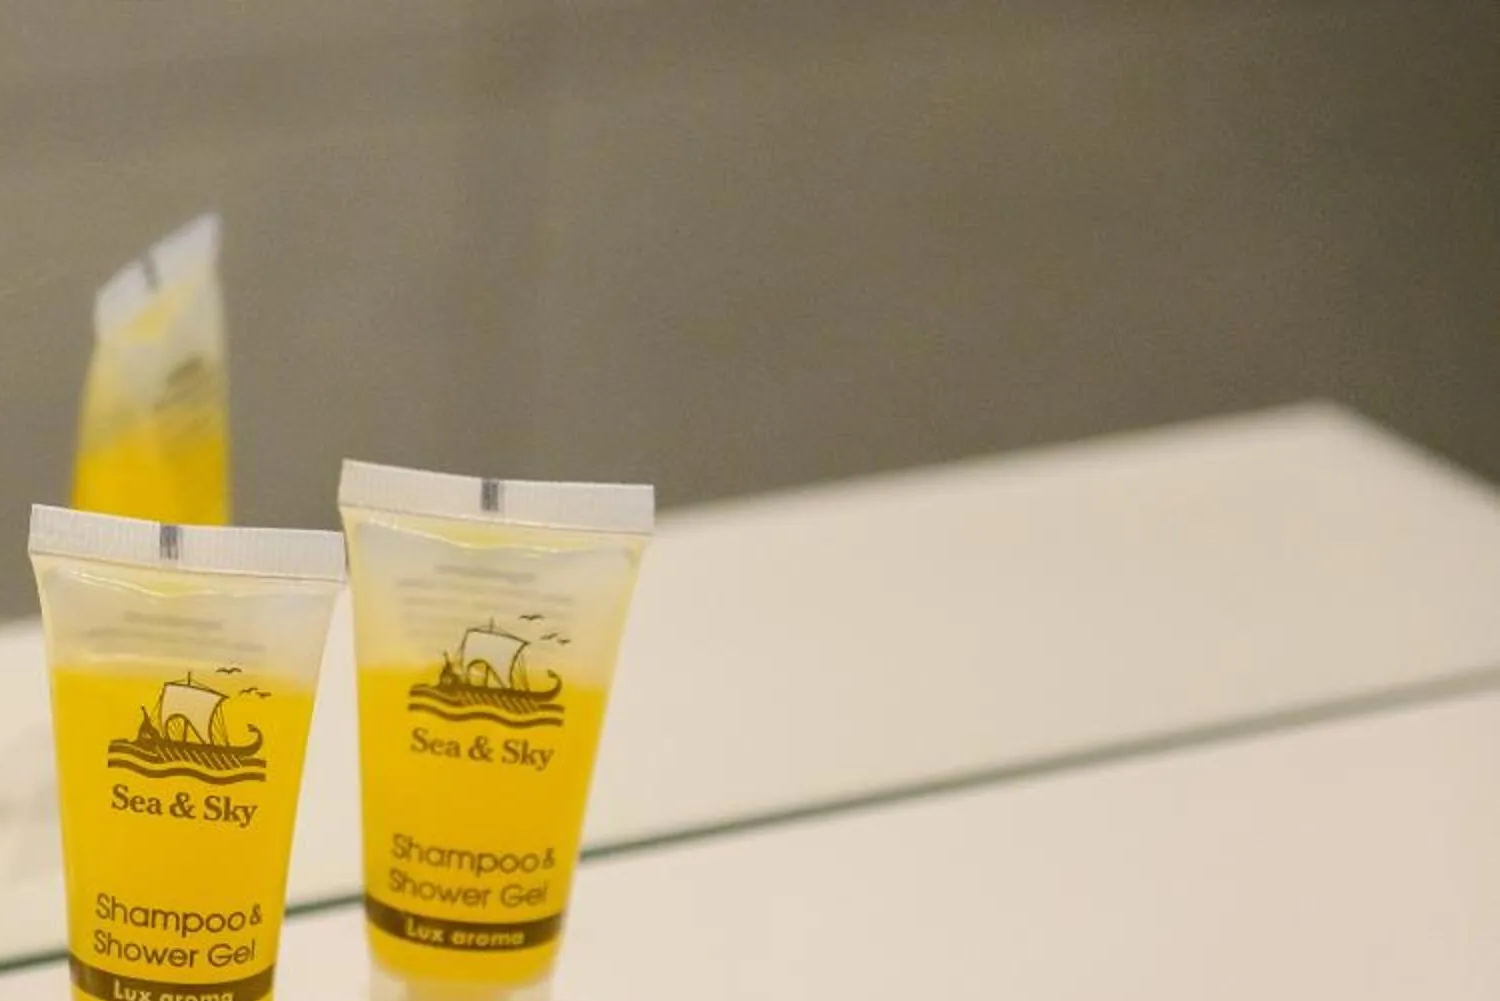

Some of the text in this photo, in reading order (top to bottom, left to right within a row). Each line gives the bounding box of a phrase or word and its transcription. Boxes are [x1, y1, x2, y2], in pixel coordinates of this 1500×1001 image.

[411, 726, 555, 772] Sea & Sky
[111, 783, 258, 829] Sea & Sky
[387, 868, 549, 909] Shower Gel
[93, 928, 257, 969] Shower Gel
[404, 915, 526, 947] Lux aroma
